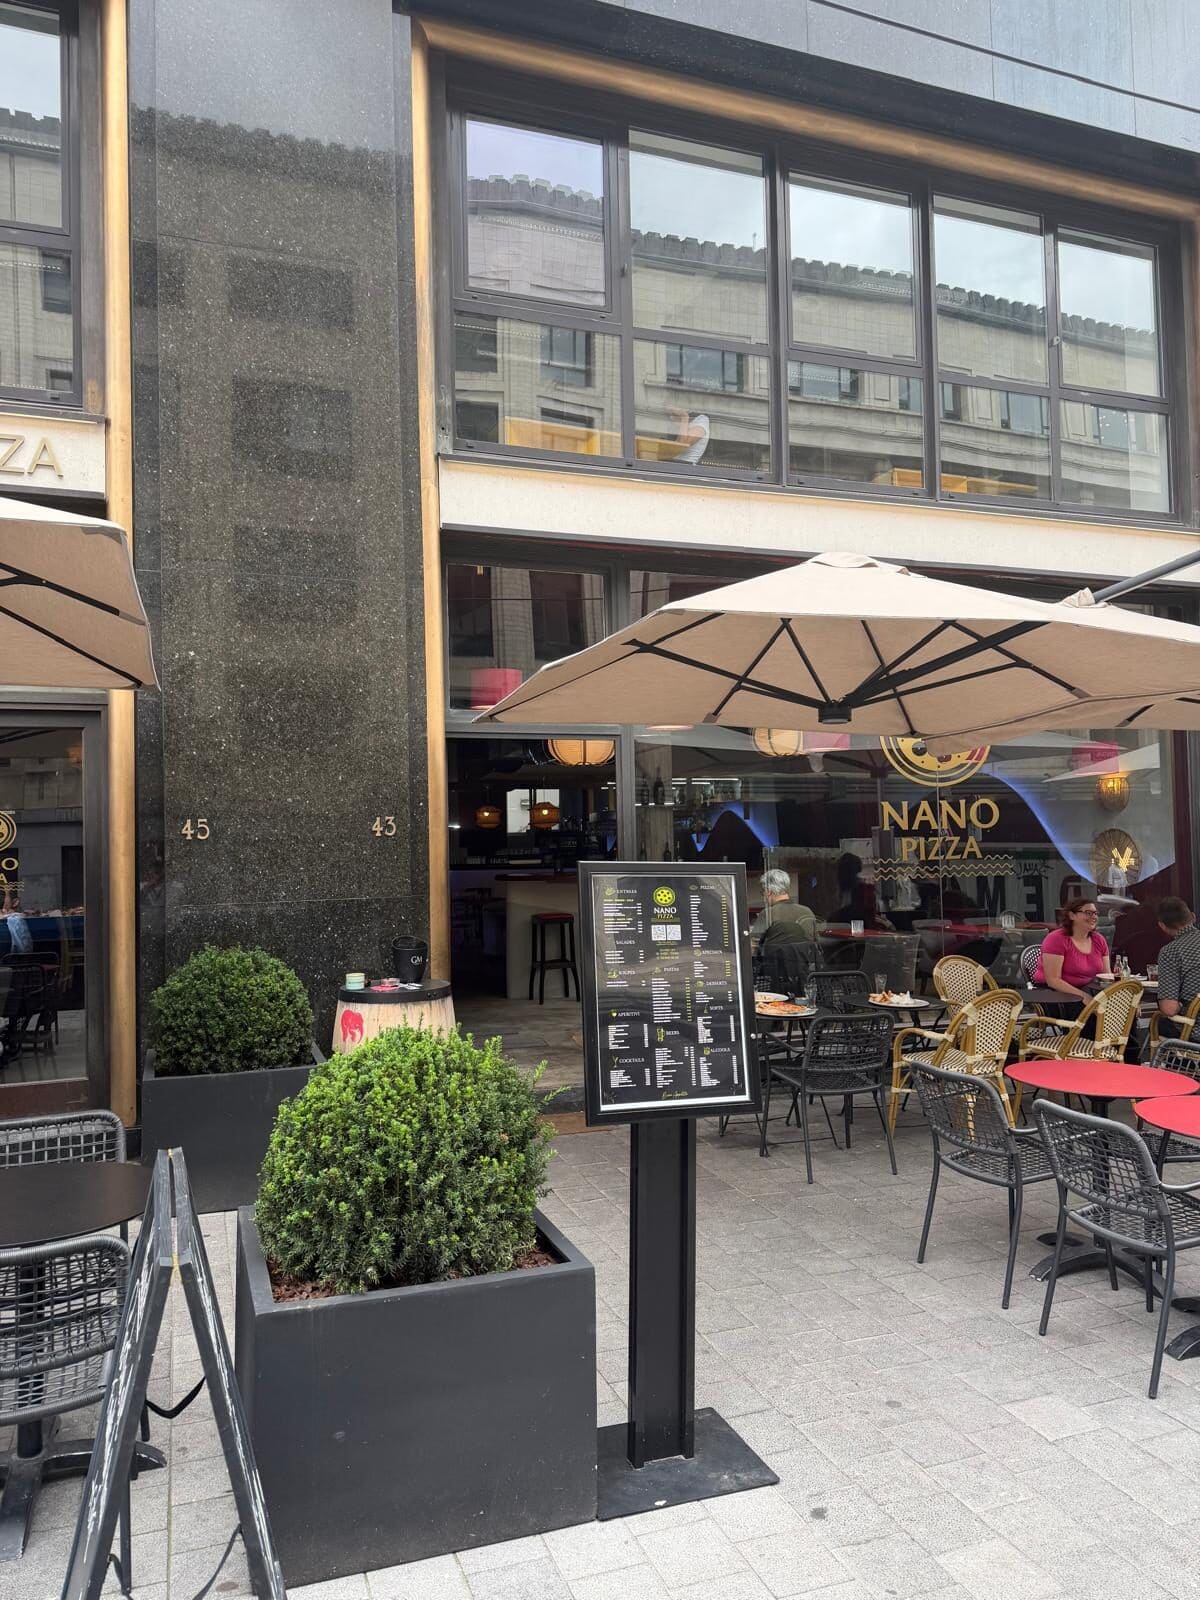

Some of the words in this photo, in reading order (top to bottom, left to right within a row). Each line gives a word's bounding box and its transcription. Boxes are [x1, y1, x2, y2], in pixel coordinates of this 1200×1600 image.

[880, 798, 1000, 831] NANO
[181, 818, 210, 840] 45
[371, 816, 397, 837] 43
[901, 836, 983, 861] PIZZA
